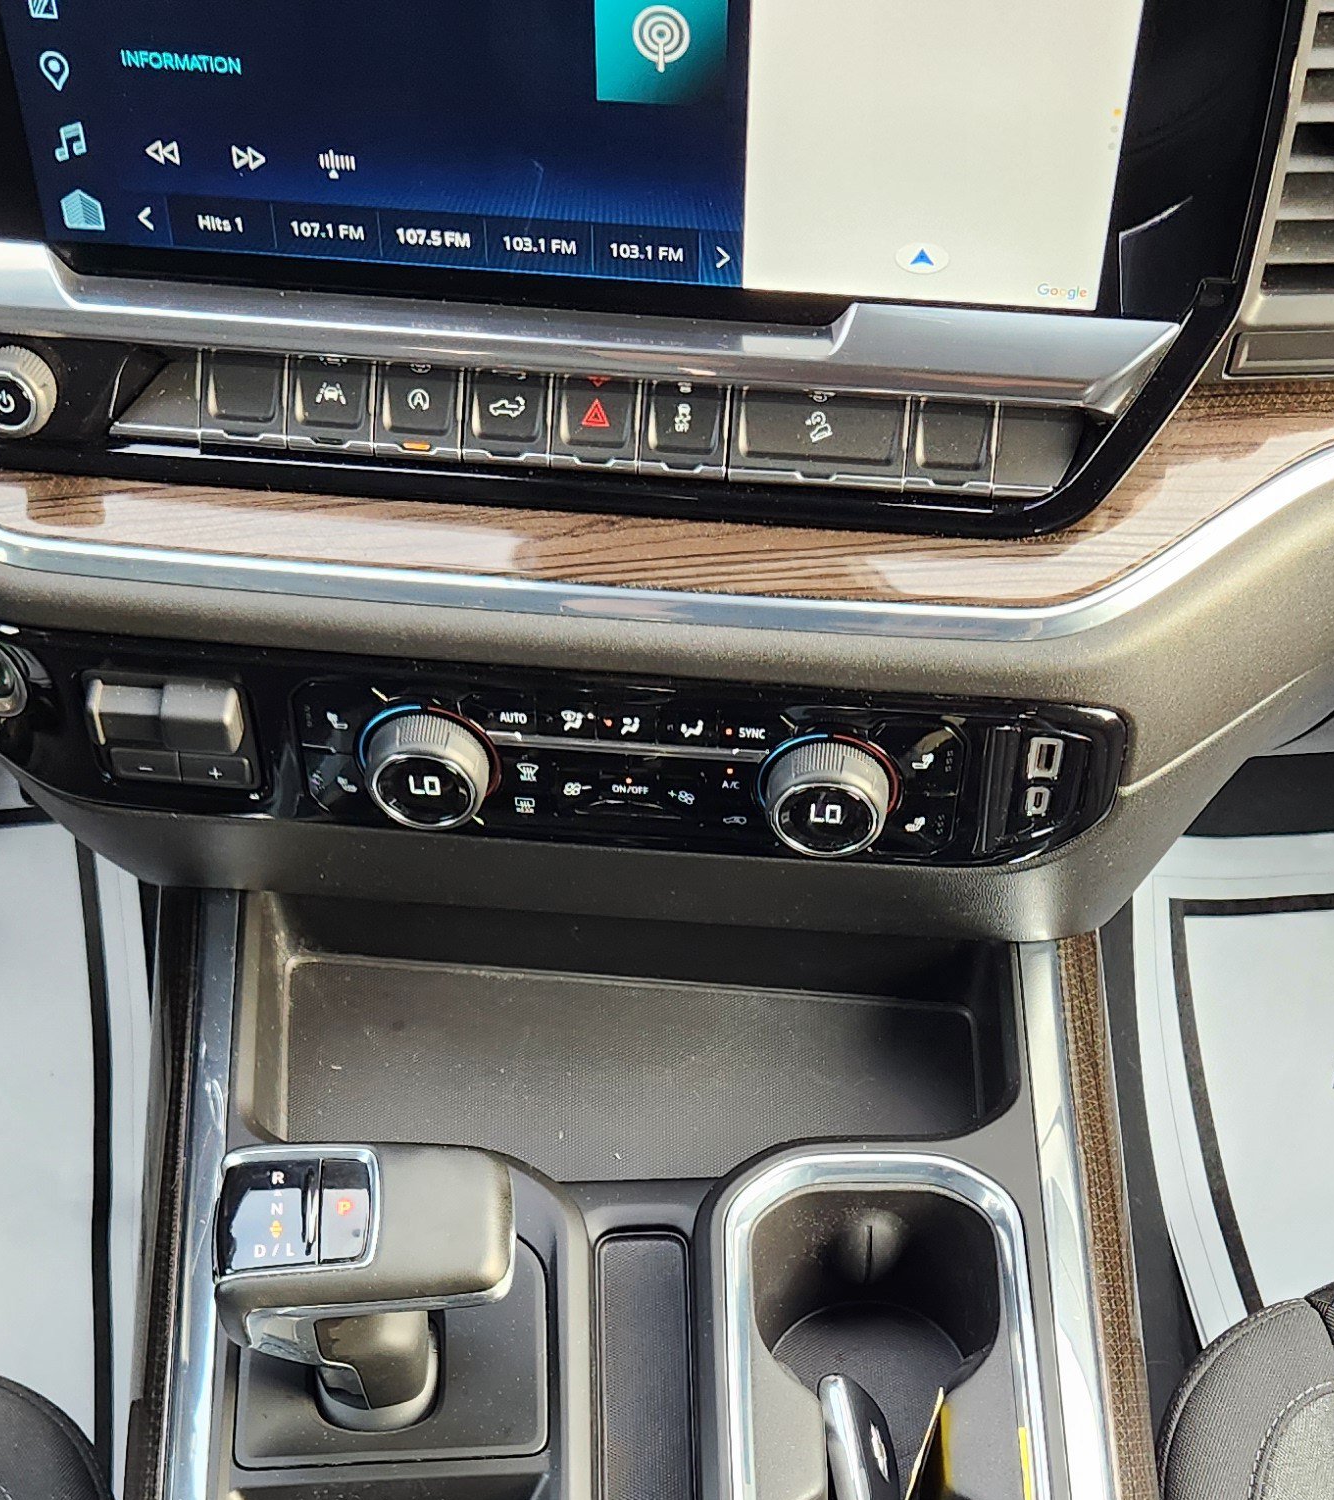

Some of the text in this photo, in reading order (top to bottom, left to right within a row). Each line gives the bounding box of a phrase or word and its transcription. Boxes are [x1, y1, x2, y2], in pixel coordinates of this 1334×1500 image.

[121, 49, 242, 75] INFORMATION
[197, 214, 243, 233] Hits 1
[290, 220, 365, 241] 107.1 FM
[396, 227, 471, 249] 107.5 FM
[503, 235, 577, 255] 103.1 FM
[610, 242, 684, 263] 103.1 FM
[1037, 283, 1087, 300] Google
[499, 711, 528, 725] AUTO
[738, 726, 766, 740] SYNC
[612, 784, 649, 795] ON/OFF
[722, 780, 740, 790] A/C
[271, 1171, 285, 1185] R
[270, 1202, 284, 1216] N
[337, 1199, 353, 1215] P
